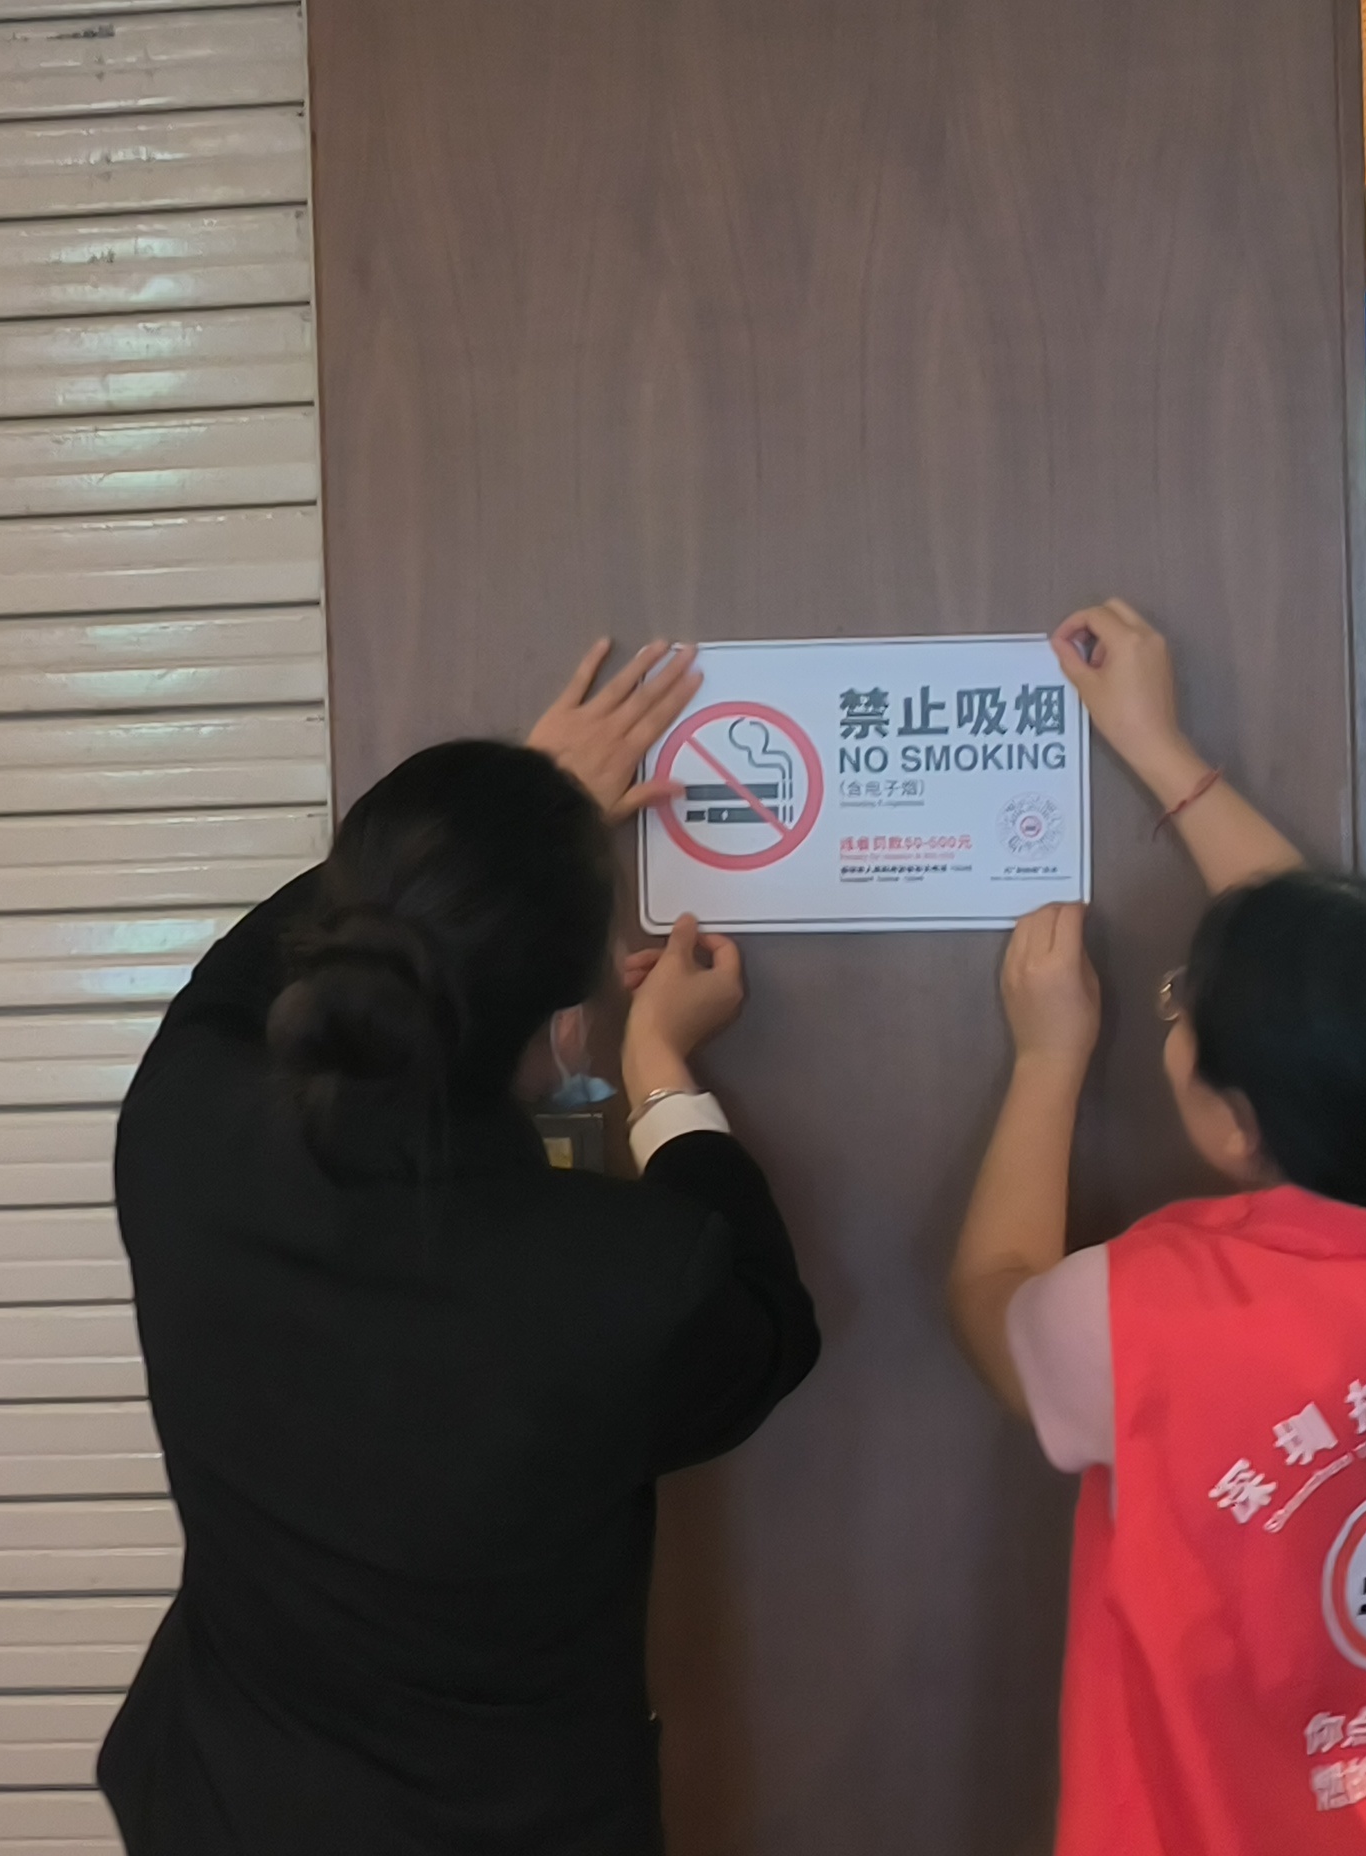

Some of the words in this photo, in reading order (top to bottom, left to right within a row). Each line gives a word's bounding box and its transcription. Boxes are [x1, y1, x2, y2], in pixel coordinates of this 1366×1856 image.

[838, 683, 1066, 740] 禁止吸烟
[838, 746, 889, 774] NO
[900, 742, 1067, 773] SMOKING
